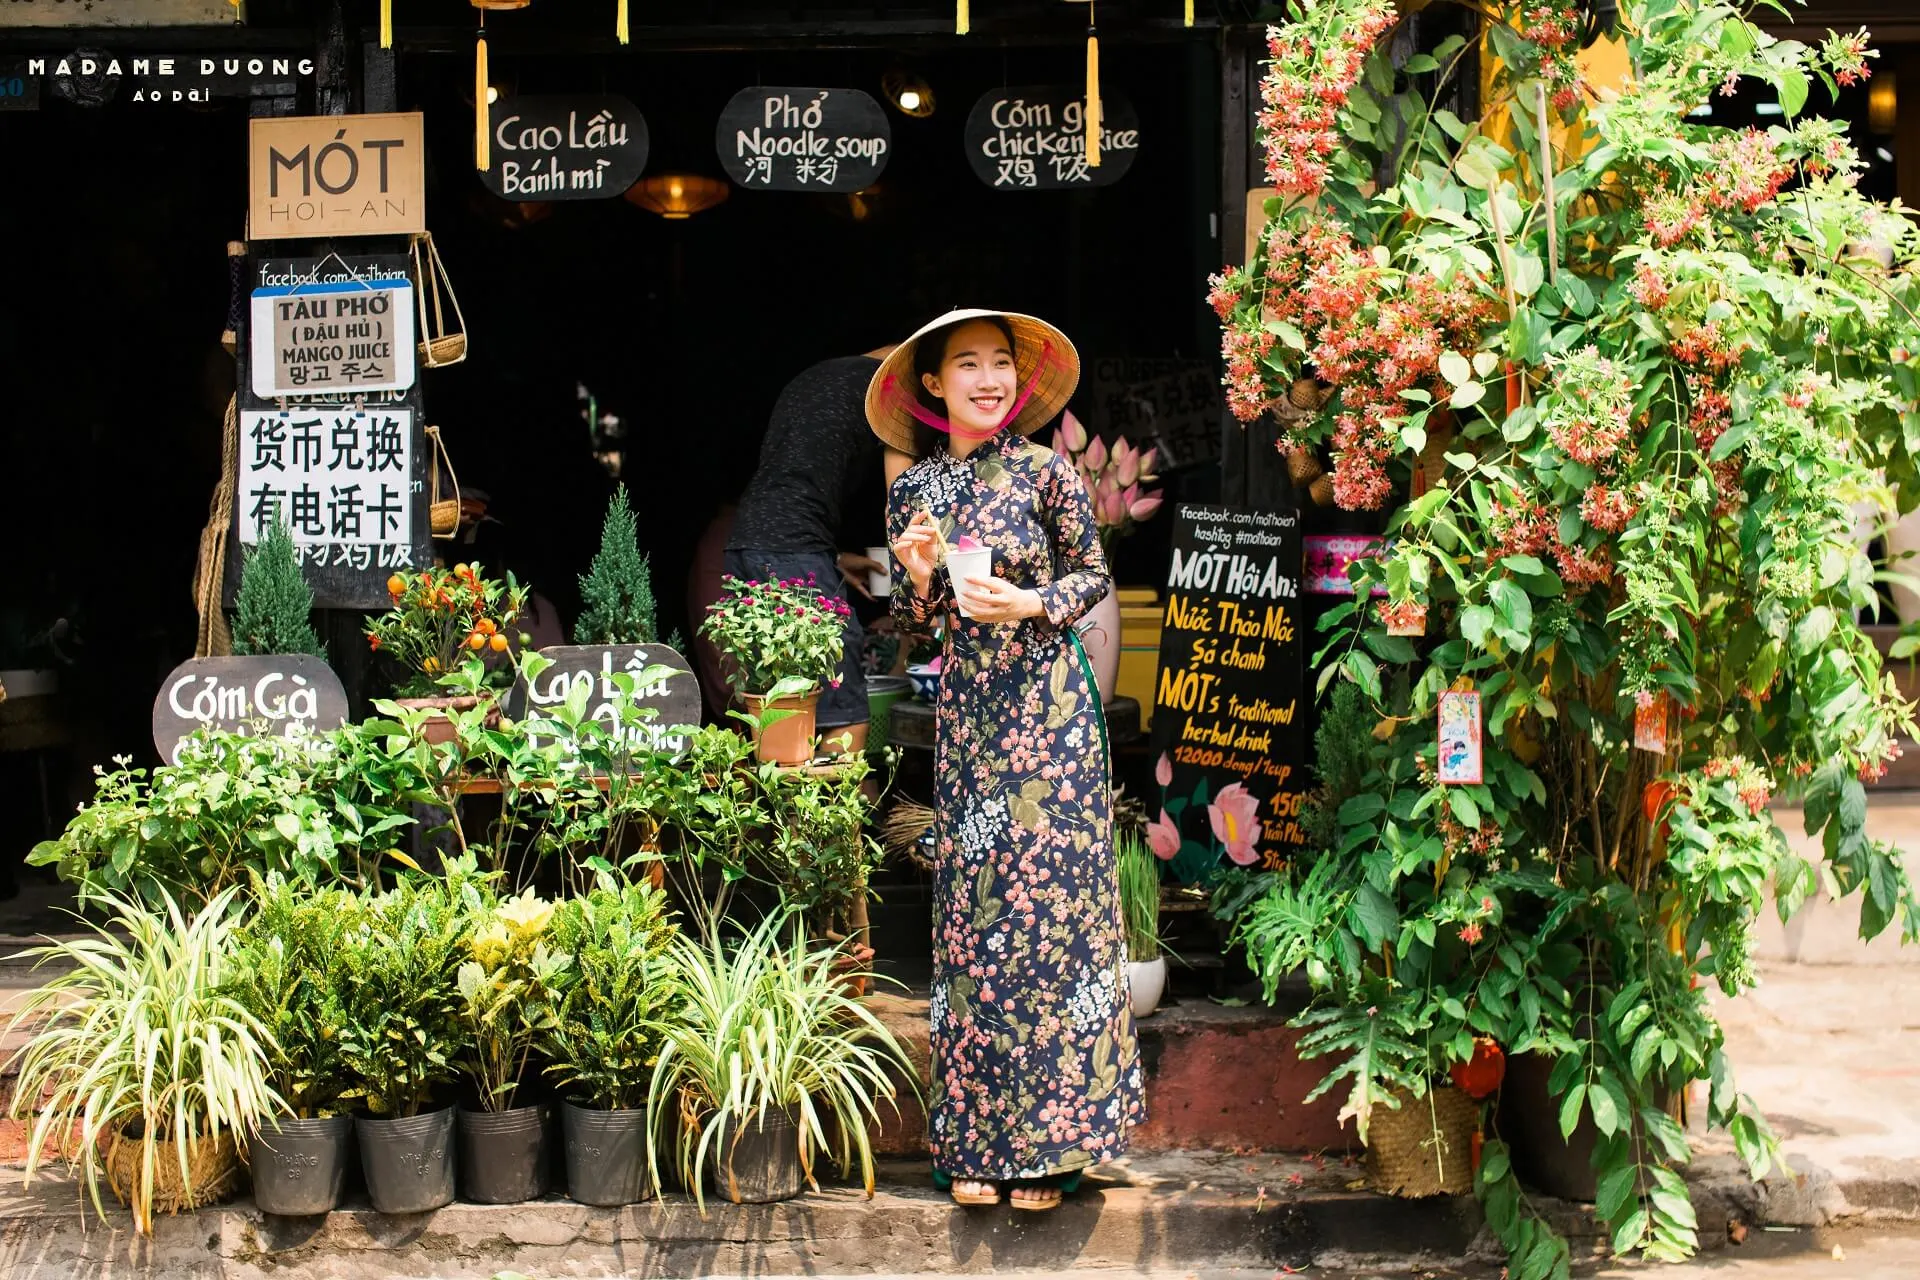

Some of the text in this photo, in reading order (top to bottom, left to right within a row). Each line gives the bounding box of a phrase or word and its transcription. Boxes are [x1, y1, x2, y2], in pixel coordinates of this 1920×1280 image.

[497, 110, 629, 150] Cao Lầu
[737, 127, 887, 167] Noodle soup
[270, 129, 404, 197] MÓT
[502, 156, 565, 194] Bánh
[279, 292, 389, 320] TÀU PHỚ
[283, 342, 390, 364] MANGO JUICE
[290, 362, 384, 385] 망고 주스
[250, 416, 403, 473] 货币兑换
[250, 483, 403, 540] 有电话卡
[1194, 524, 1232, 549] hashtag
[1168, 545, 1230, 593] MÓT
[1226, 555, 1260, 600] Hội
[1217, 601, 1260, 637] Thảo
[1261, 605, 1294, 647] Mộc
[1221, 637, 1265, 671] chanh
[255, 673, 318, 719] Gà
[1228, 693, 1296, 726] traditional
[1182, 716, 1272, 754] herbal drink
[1174, 745, 1223, 767] 12000
[1269, 791, 1302, 817] 150
